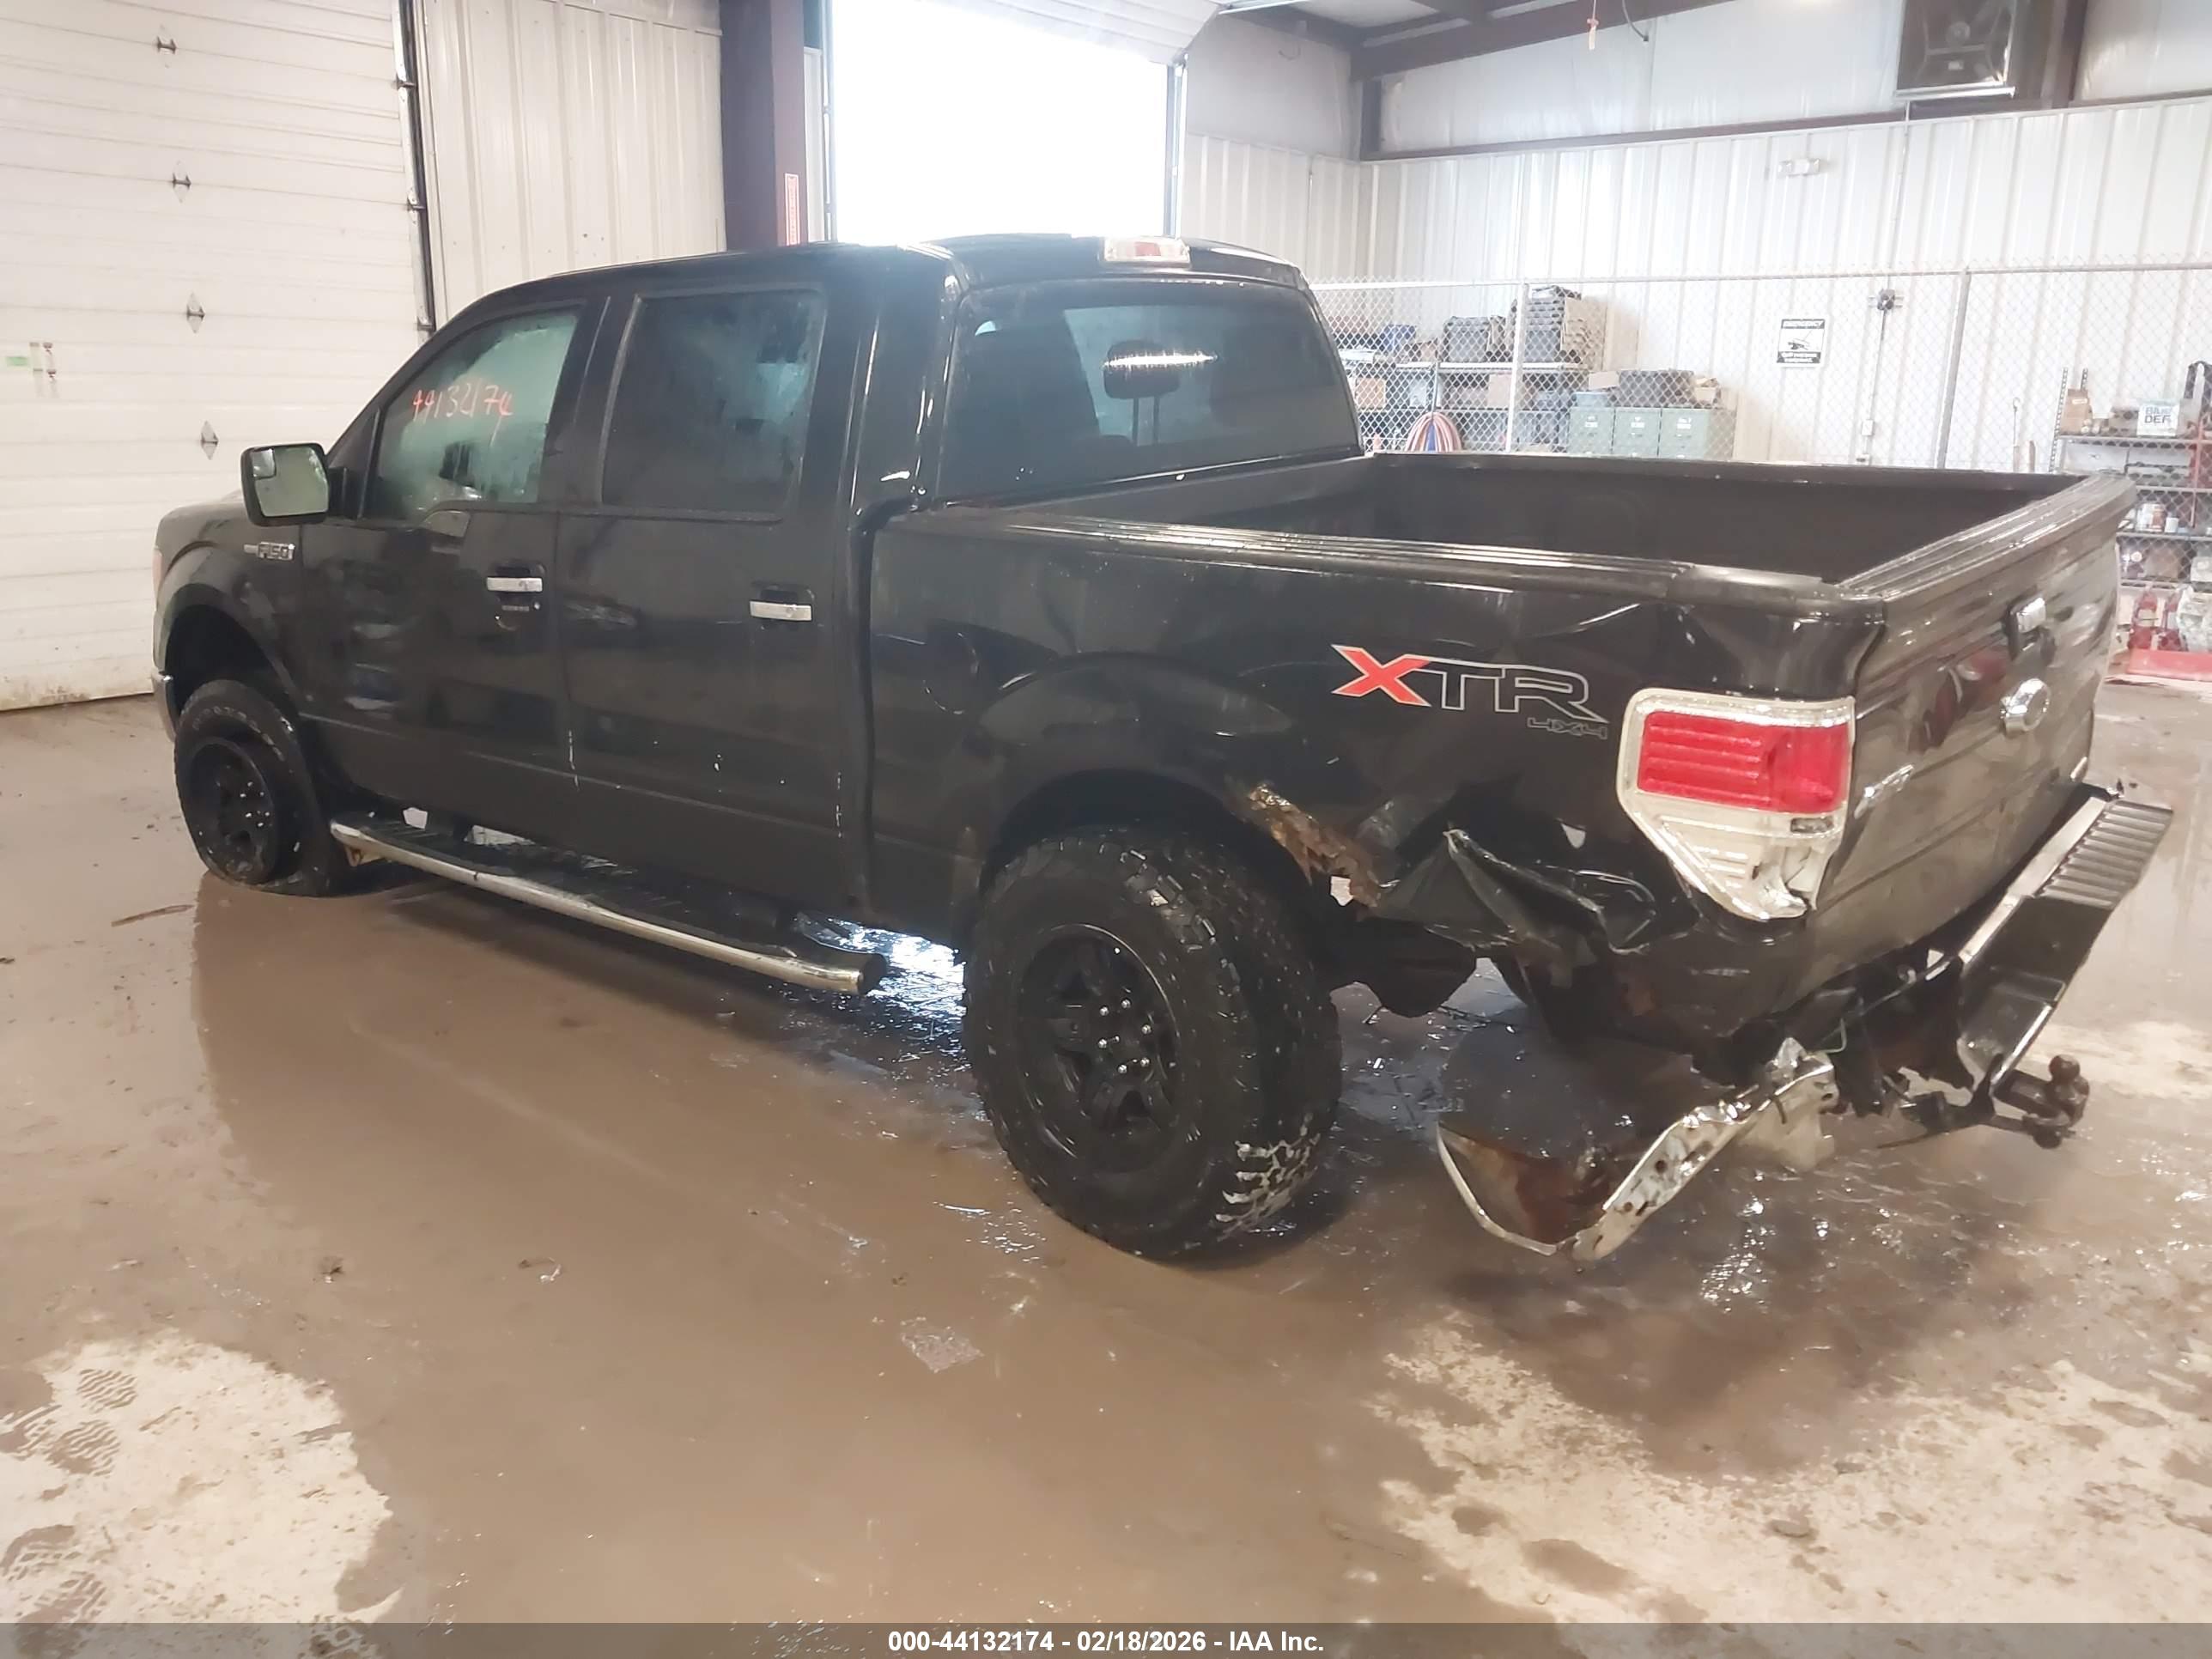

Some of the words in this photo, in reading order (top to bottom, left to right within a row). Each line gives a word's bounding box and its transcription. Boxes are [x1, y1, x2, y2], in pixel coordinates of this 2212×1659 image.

[412, 382, 515, 447] 44132174
[2144, 415, 2172, 423] DEF
[1330, 643, 1610, 724] XTR
